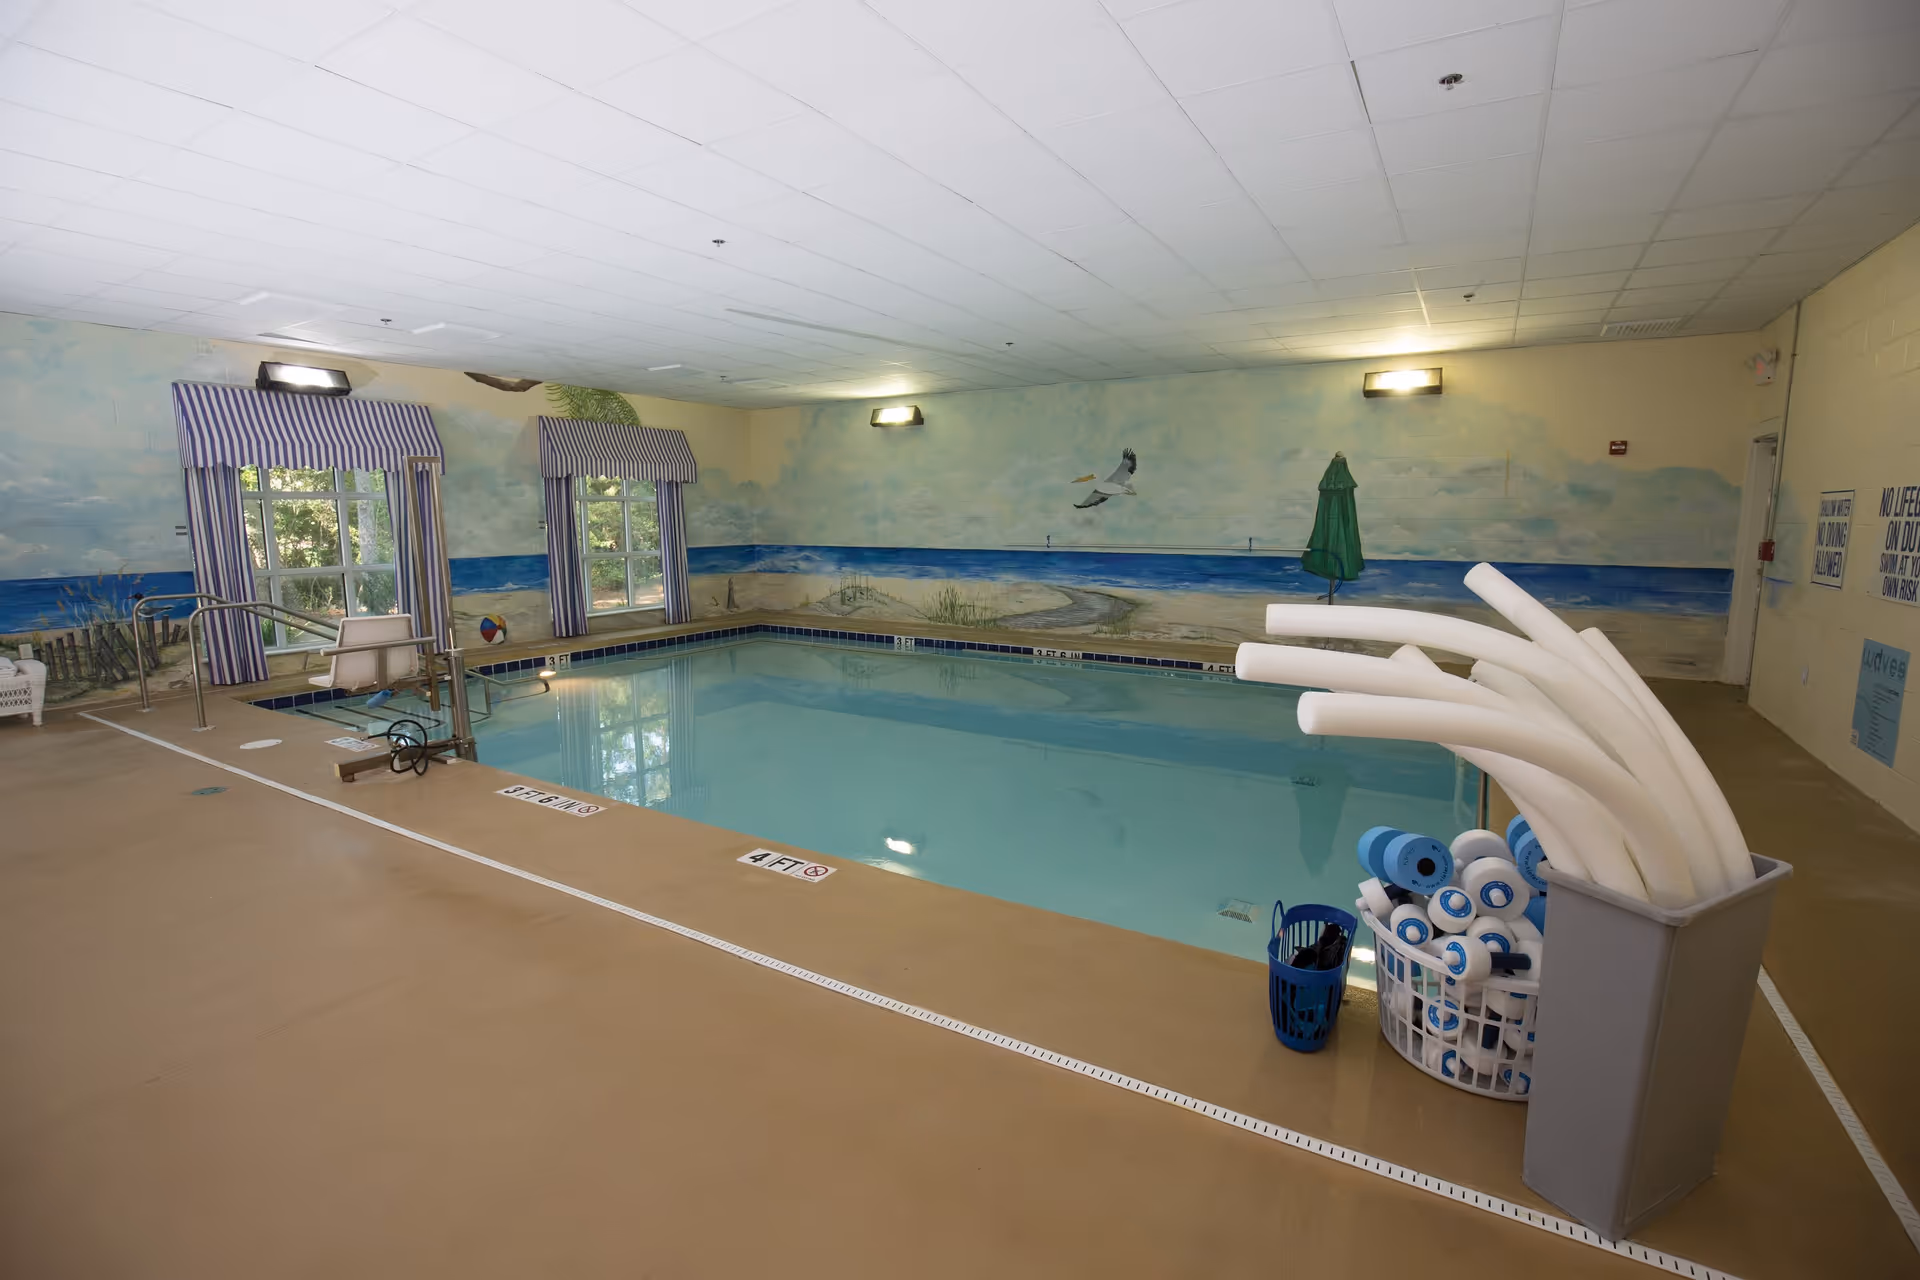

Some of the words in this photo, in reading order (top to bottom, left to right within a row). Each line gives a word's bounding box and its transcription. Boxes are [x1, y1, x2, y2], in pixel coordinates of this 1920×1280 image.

[1879, 487, 1894, 517] NO
[1885, 520, 1901, 551] ON
[1814, 550, 1842, 578] ALLOWED
[1879, 553, 1899, 574] SWIM
[1898, 555, 1910, 576] AT
[1882, 576, 1899, 598] OWN
[1899, 579, 1919, 602] RISK
[549, 656, 555, 665] 3
[559, 654, 570, 664] FT
[504, 786, 525, 794] 3
[515, 790, 546, 799] FT
[538, 795, 560, 804] 6
[553, 799, 581, 810] IN
[749, 852, 772, 863] 4
[768, 857, 805, 871] FT
